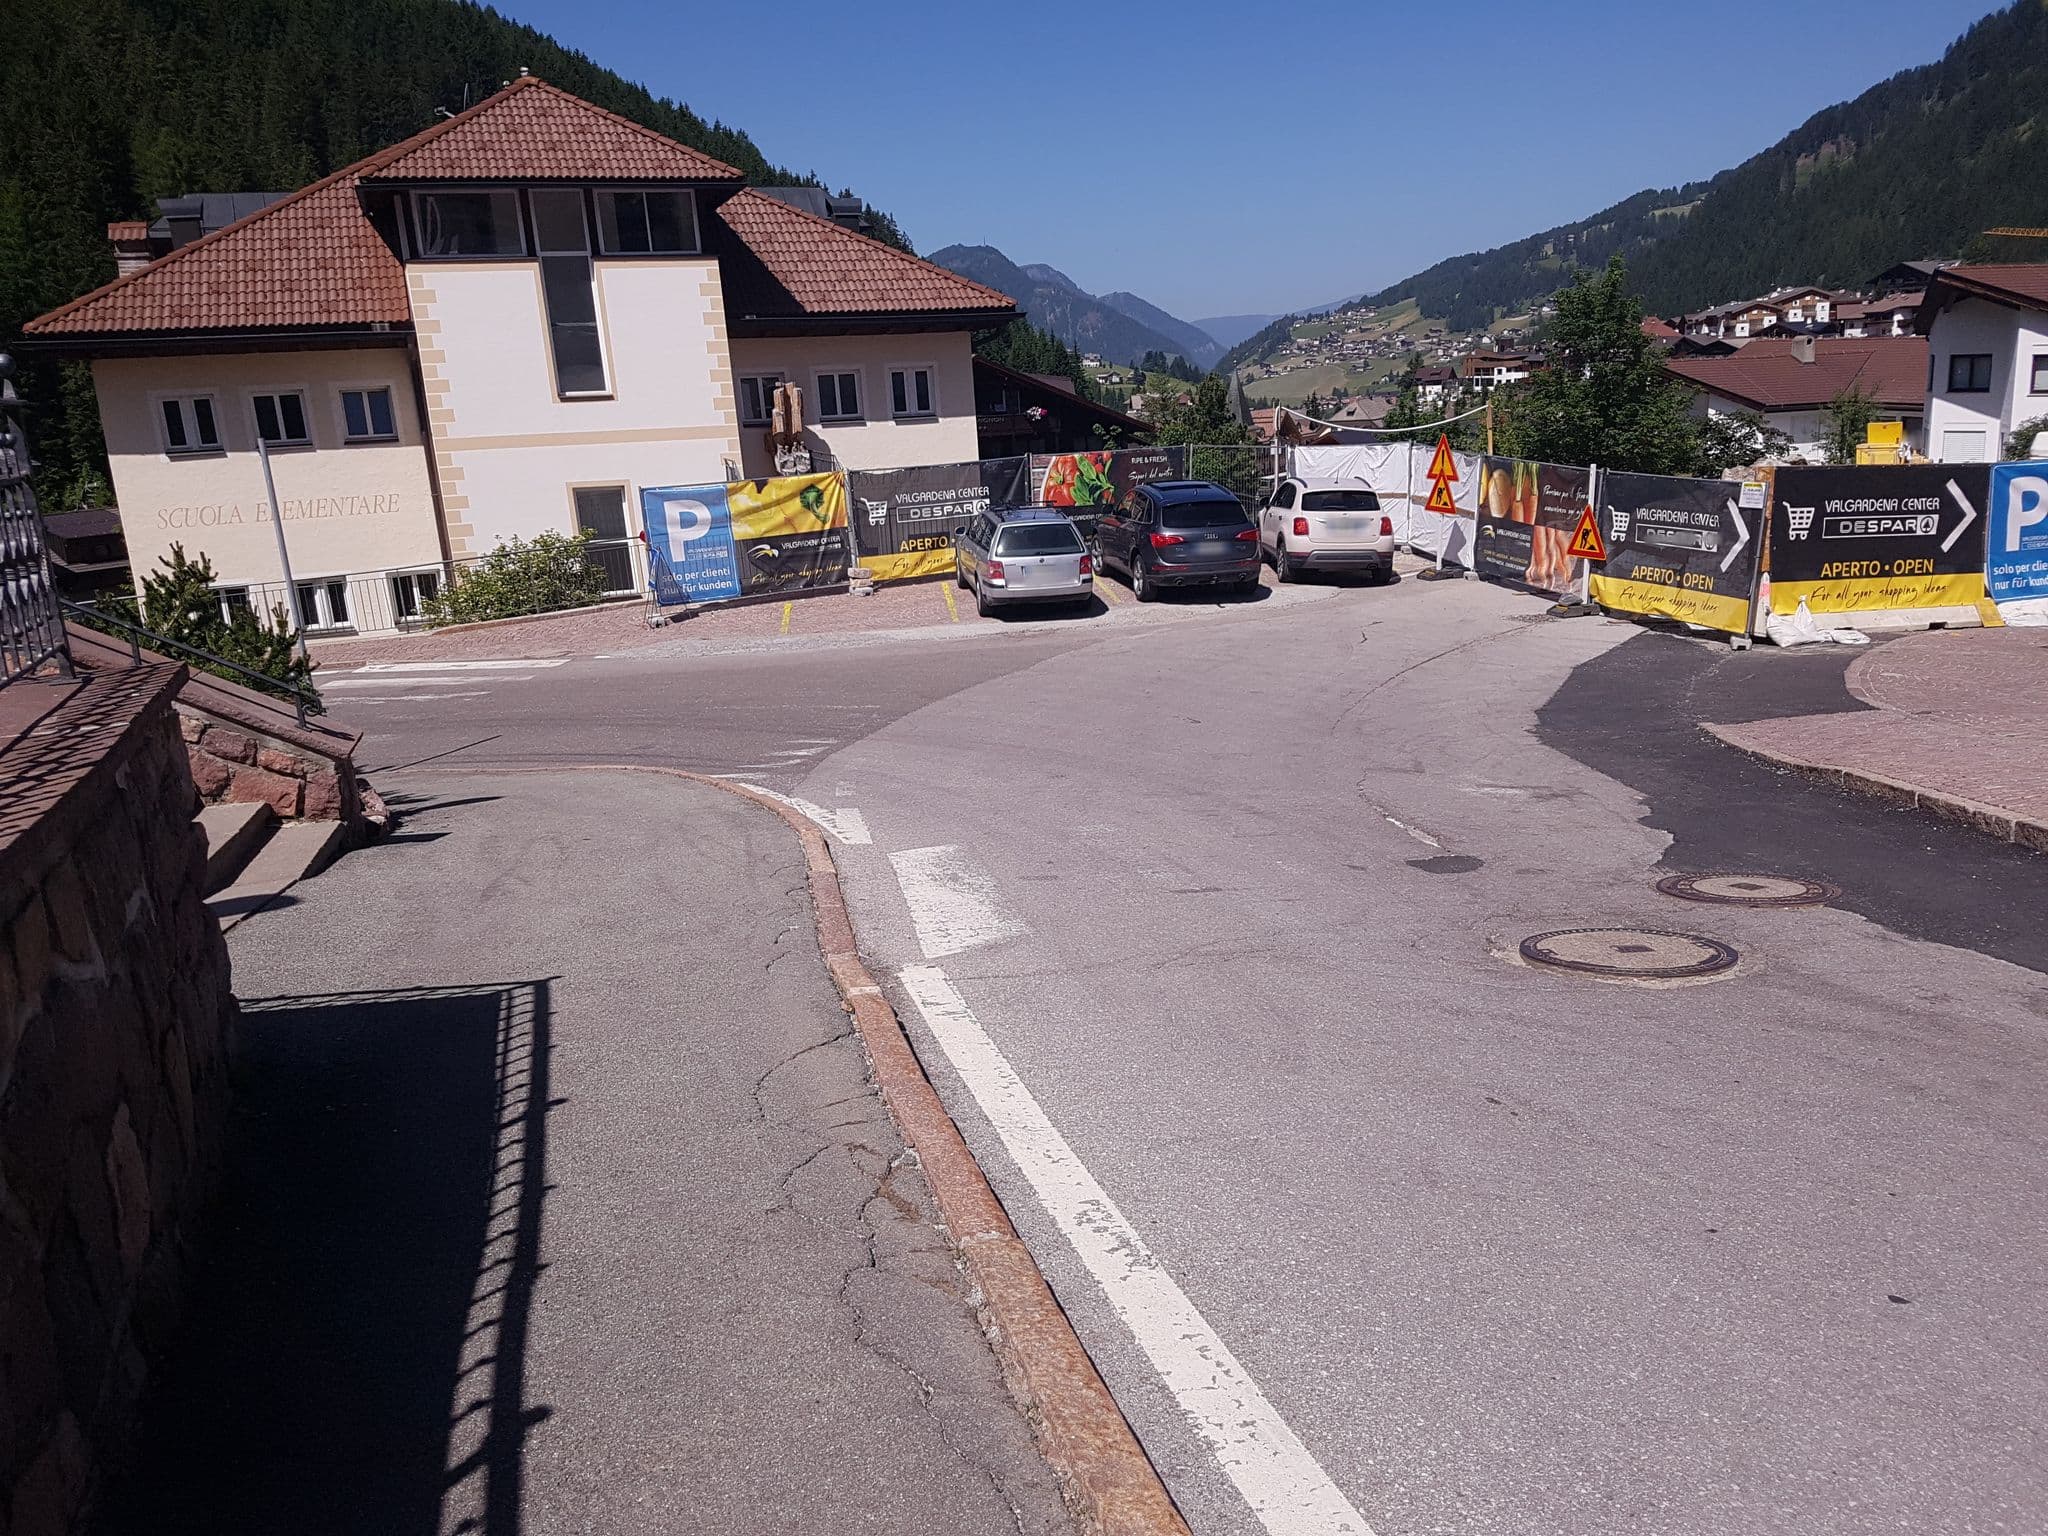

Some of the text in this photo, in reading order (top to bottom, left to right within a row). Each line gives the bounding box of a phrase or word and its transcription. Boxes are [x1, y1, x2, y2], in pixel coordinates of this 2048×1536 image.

[895, 486, 990, 503] VALGARDENA CENTER
[157, 493, 400, 529] SCUOLA EEMENTARE
[910, 504, 973, 519] DESPAR
[1825, 497, 1940, 513] VALGARDENA CENTER
[1636, 507, 1720, 528] VALGARDENA CENTER
[2006, 476, 2048, 552] P
[664, 500, 711, 562] P
[1840, 519, 1917, 534] DESPAR
[900, 535, 948, 552] APERTO
[663, 567, 730, 582] solo per clienti
[1820, 558, 1934, 577] APERTO OPEN
[1993, 563, 2014, 576] solo
[2015, 564, 2030, 576] per
[682, 583, 697, 592] für
[698, 580, 732, 591] kunden
[1631, 565, 1714, 591] APERTO OPEN
[1994, 580, 2009, 590] nur
[2012, 576, 2028, 588] für
[1620, 585, 1635, 599] For
[1810, 585, 1830, 602] For
[1836, 581, 1851, 600] all
[1845, 590, 1873, 608] your
[1879, 577, 1918, 606] shopping
